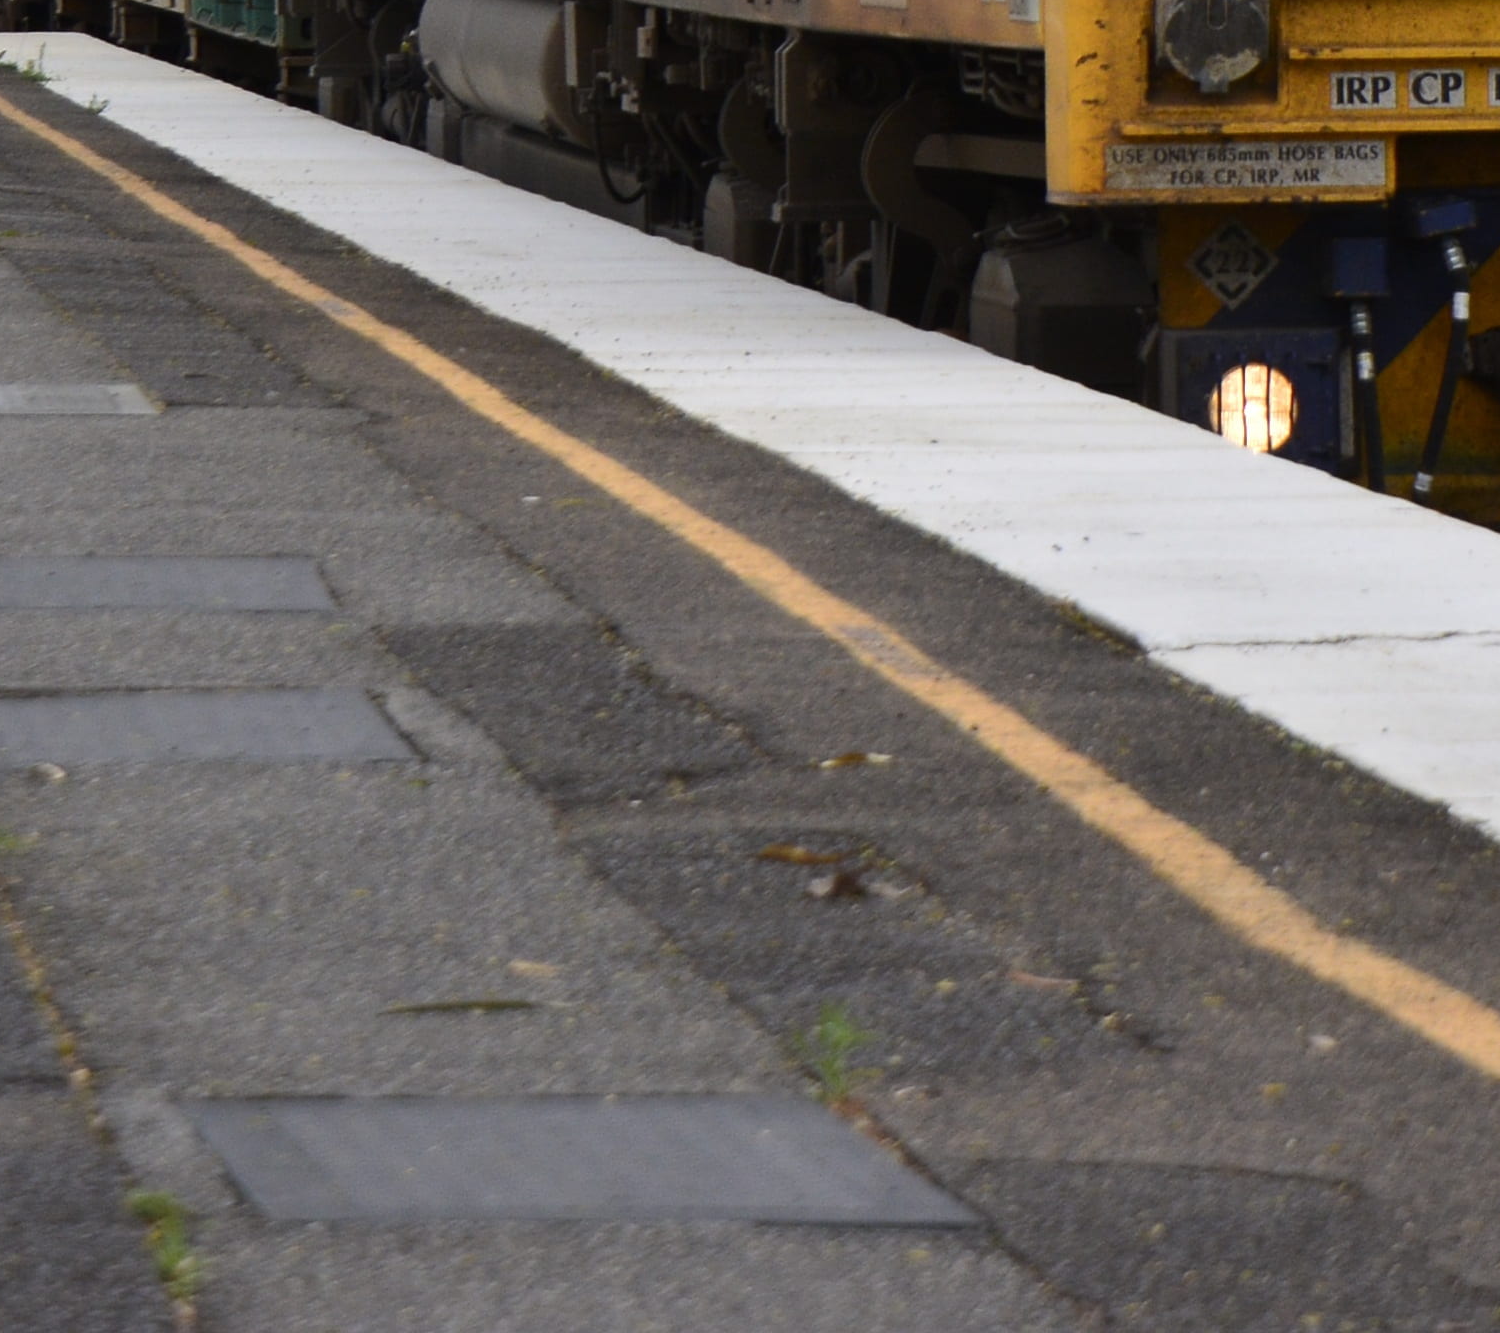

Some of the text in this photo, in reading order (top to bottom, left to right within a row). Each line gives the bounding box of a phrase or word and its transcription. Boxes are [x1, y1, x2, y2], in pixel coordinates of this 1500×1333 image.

[1335, 76, 1392, 106] IRP
[1411, 72, 1464, 106] CP
[1112, 147, 1145, 164] USE
[1153, 147, 1199, 164] ONLY
[1278, 144, 1326, 161] HOSE
[1334, 144, 1380, 161] BAGS
[1170, 170, 1202, 186] FOR
[1293, 168, 1321, 183] MR
